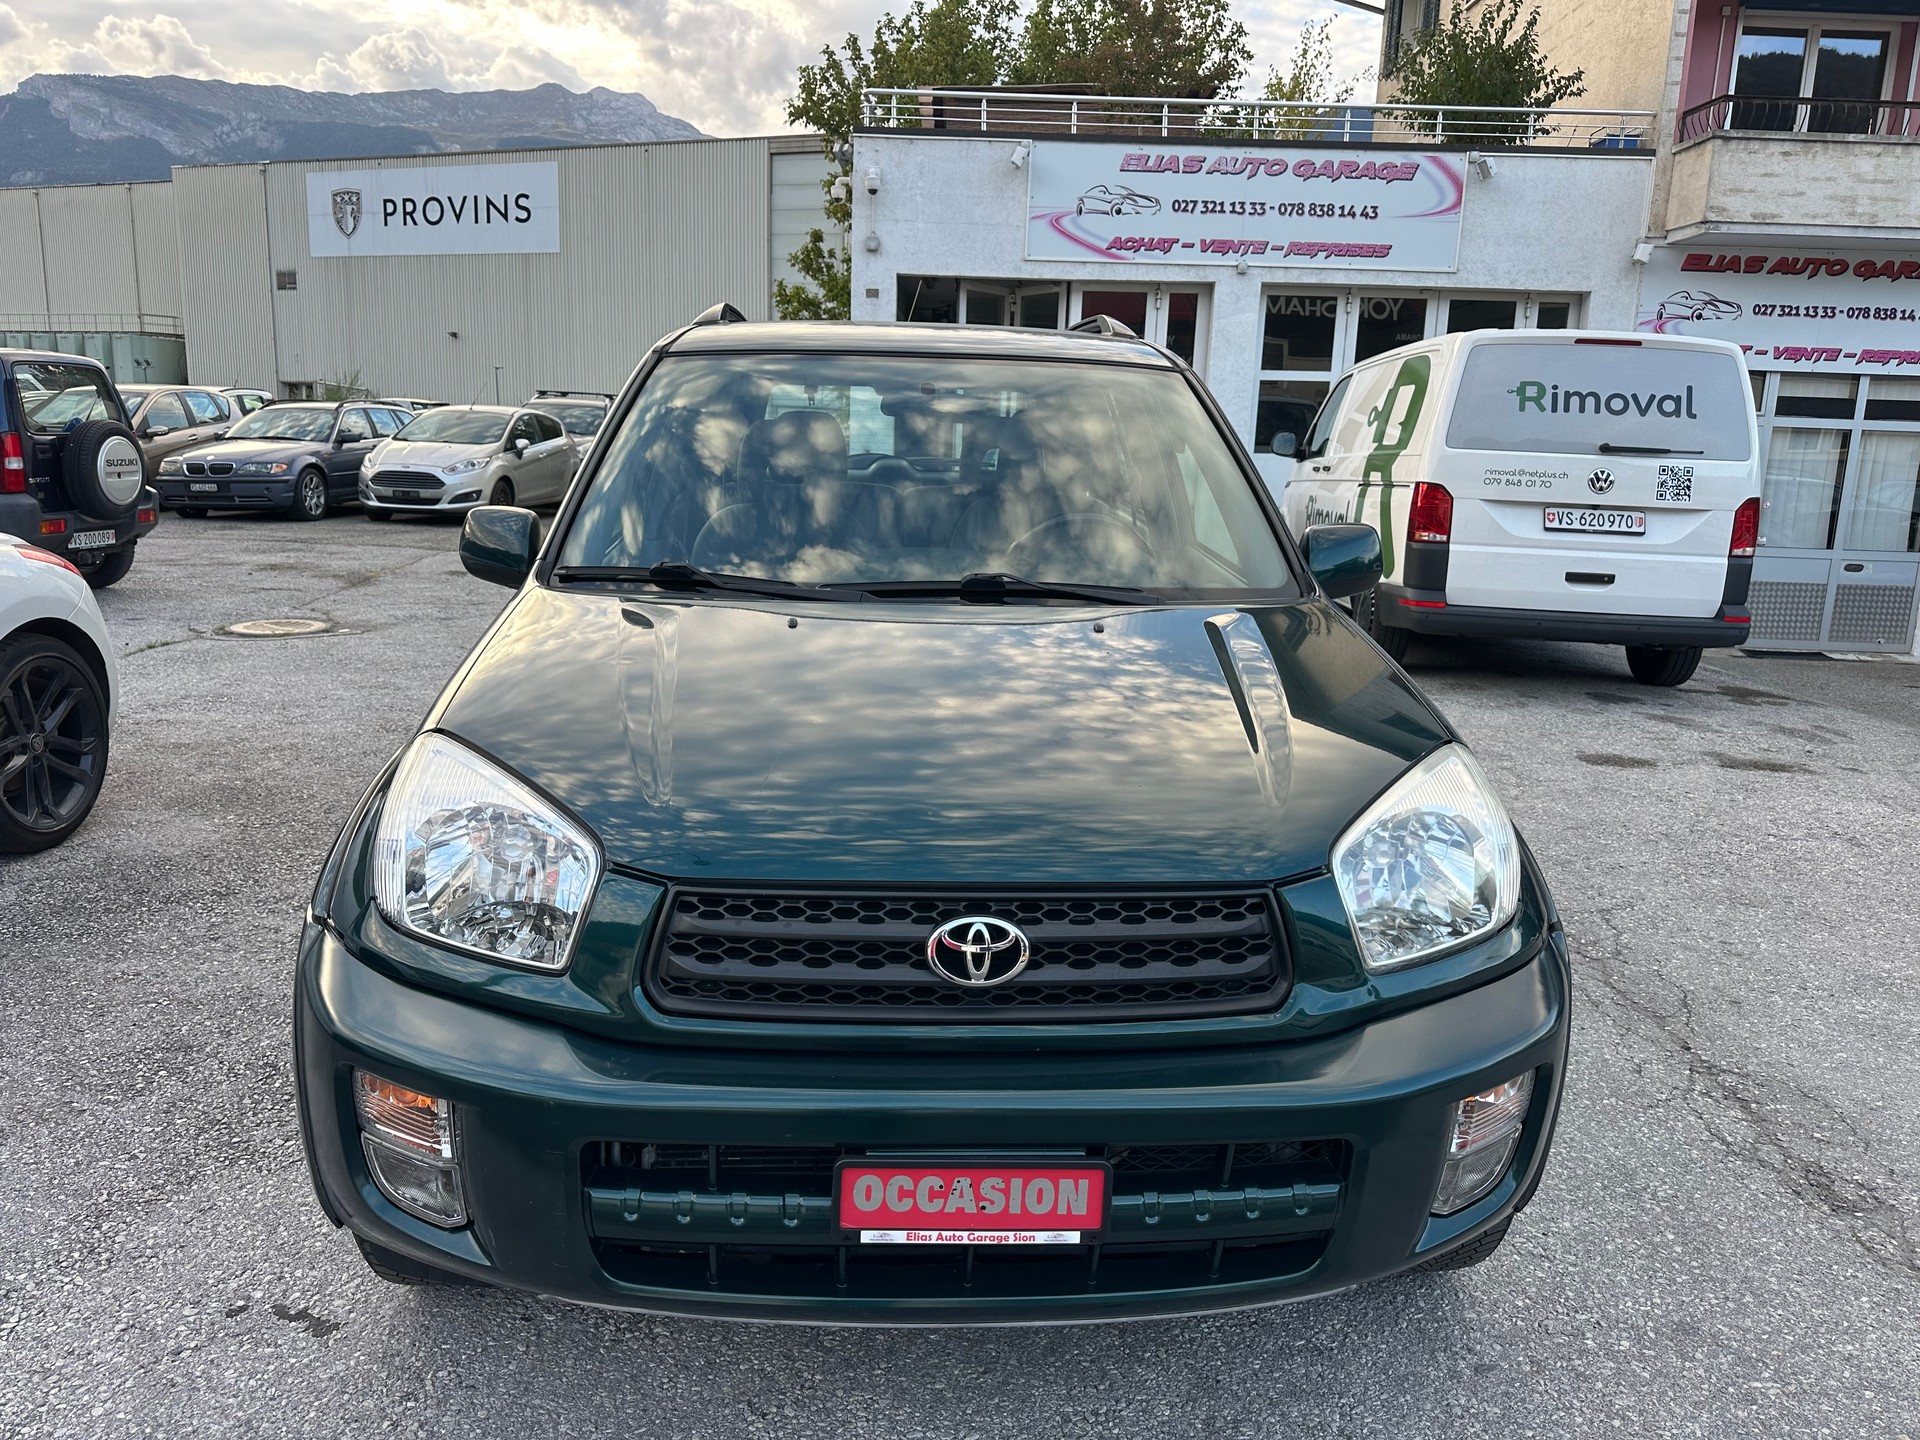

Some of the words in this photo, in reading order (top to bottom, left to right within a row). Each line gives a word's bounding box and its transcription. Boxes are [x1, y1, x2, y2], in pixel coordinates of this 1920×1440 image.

[1119, 153, 1206, 174] ELIAS
[1205, 157, 1288, 180] AUTO
[1292, 160, 1420, 184] GARAGE
[382, 193, 532, 227] PROVINS
[1171, 199, 1197, 214] 027
[1200, 200, 1226, 215] 321
[1229, 201, 1246, 215] 13
[1248, 201, 1267, 215] 33
[1278, 202, 1304, 217] 078
[1308, 203, 1335, 218] 838
[1338, 205, 1356, 219] 14
[1359, 205, 1379, 220] 43
[1105, 237, 1180, 256] ACHAT
[1199, 239, 1269, 257] VENTE
[1283, 241, 1392, 258] REPRISES
[1680, 253, 1768, 275] ELIAS
[1766, 256, 1849, 280] AUTO
[1853, 259, 1920, 283] GAR
[1752, 303, 1773, 317] 027
[1779, 304, 1801, 318] 321
[1803, 305, 1819, 318] 13
[1820, 306, 1837, 319] 33
[1846, 306, 1871, 320] 078
[1872, 307, 1897, 321] 838
[1899, 308, 1916, 322] 14
[1772, 346, 1842, 363] VENTE
[1510, 380, 1697, 420] Rimoval
[105, 458, 138, 467] SUZUKI
[1483, 478, 1502, 487] 079
[1504, 479, 1522, 487] 848
[1539, 480, 1552, 489] 70
[1484, 468, 1569, 480] rimoval@netplus.ch
[852, 1174, 1090, 1216] OCCASION
[906, 1232, 932, 1242] Elias
[936, 1232, 964, 1242] Auto
[967, 1232, 1010, 1243] Garage
[1013, 1232, 1036, 1242] Sion
